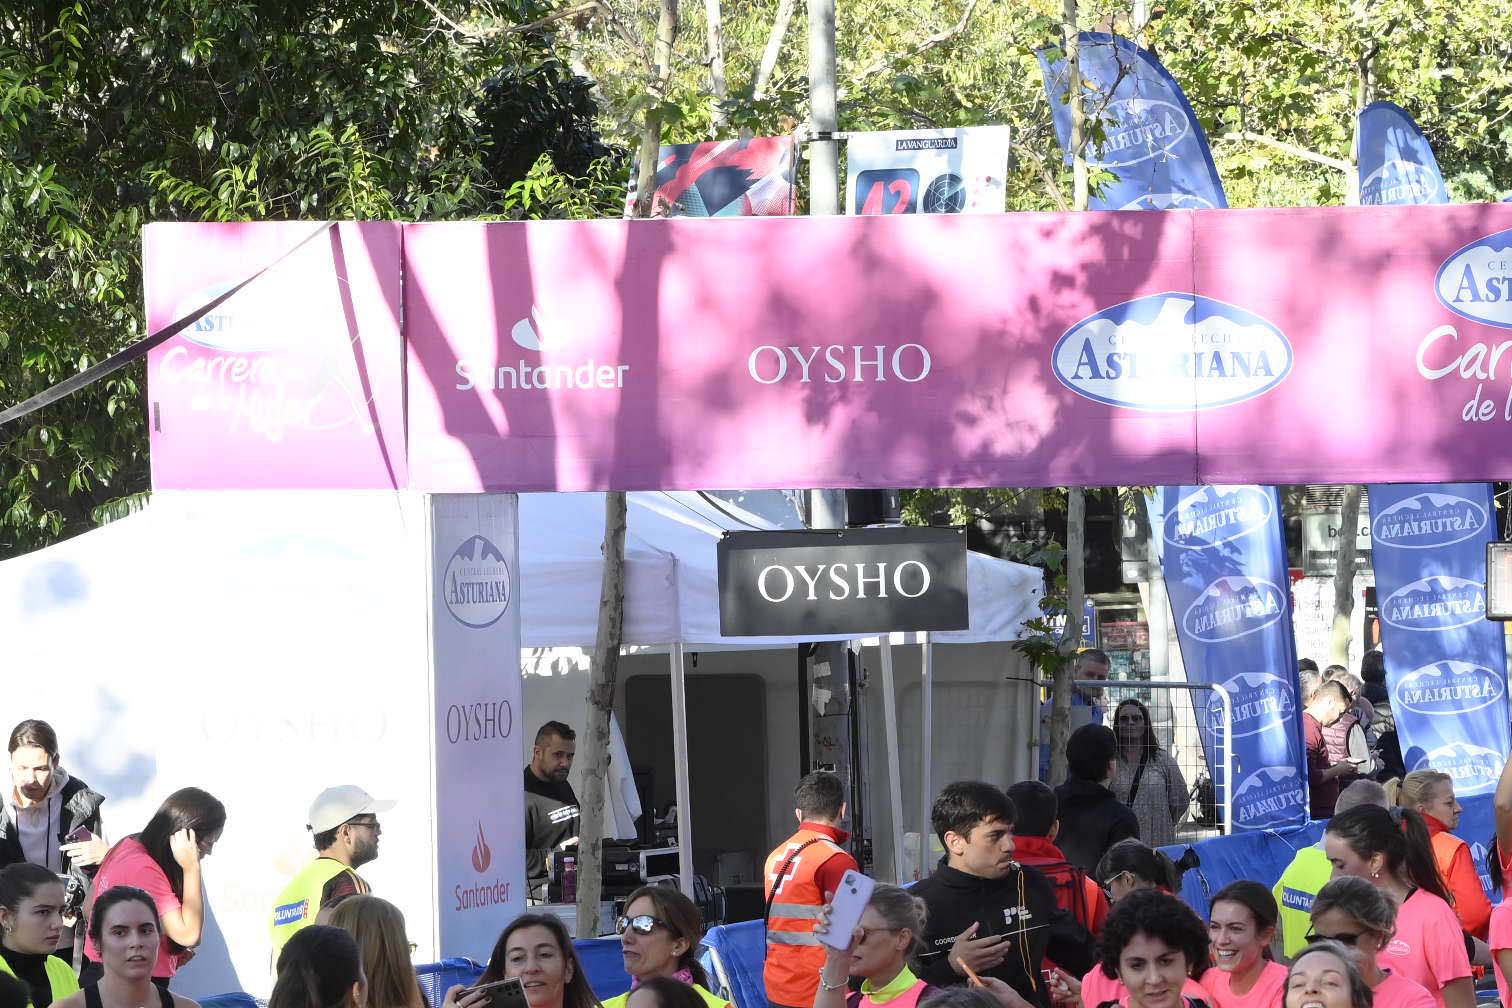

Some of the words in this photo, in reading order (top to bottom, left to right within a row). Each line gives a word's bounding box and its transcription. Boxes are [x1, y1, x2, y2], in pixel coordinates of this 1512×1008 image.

[455, 359, 629, 391] Santander
[748, 343, 931, 385] OYSHO
[1462, 383, 1496, 422] de
[449, 571, 507, 605] ASTURIANA
[758, 560, 930, 602] OYSHO
[447, 700, 512, 744] OYSHO
[455, 880, 510, 912] Santander
